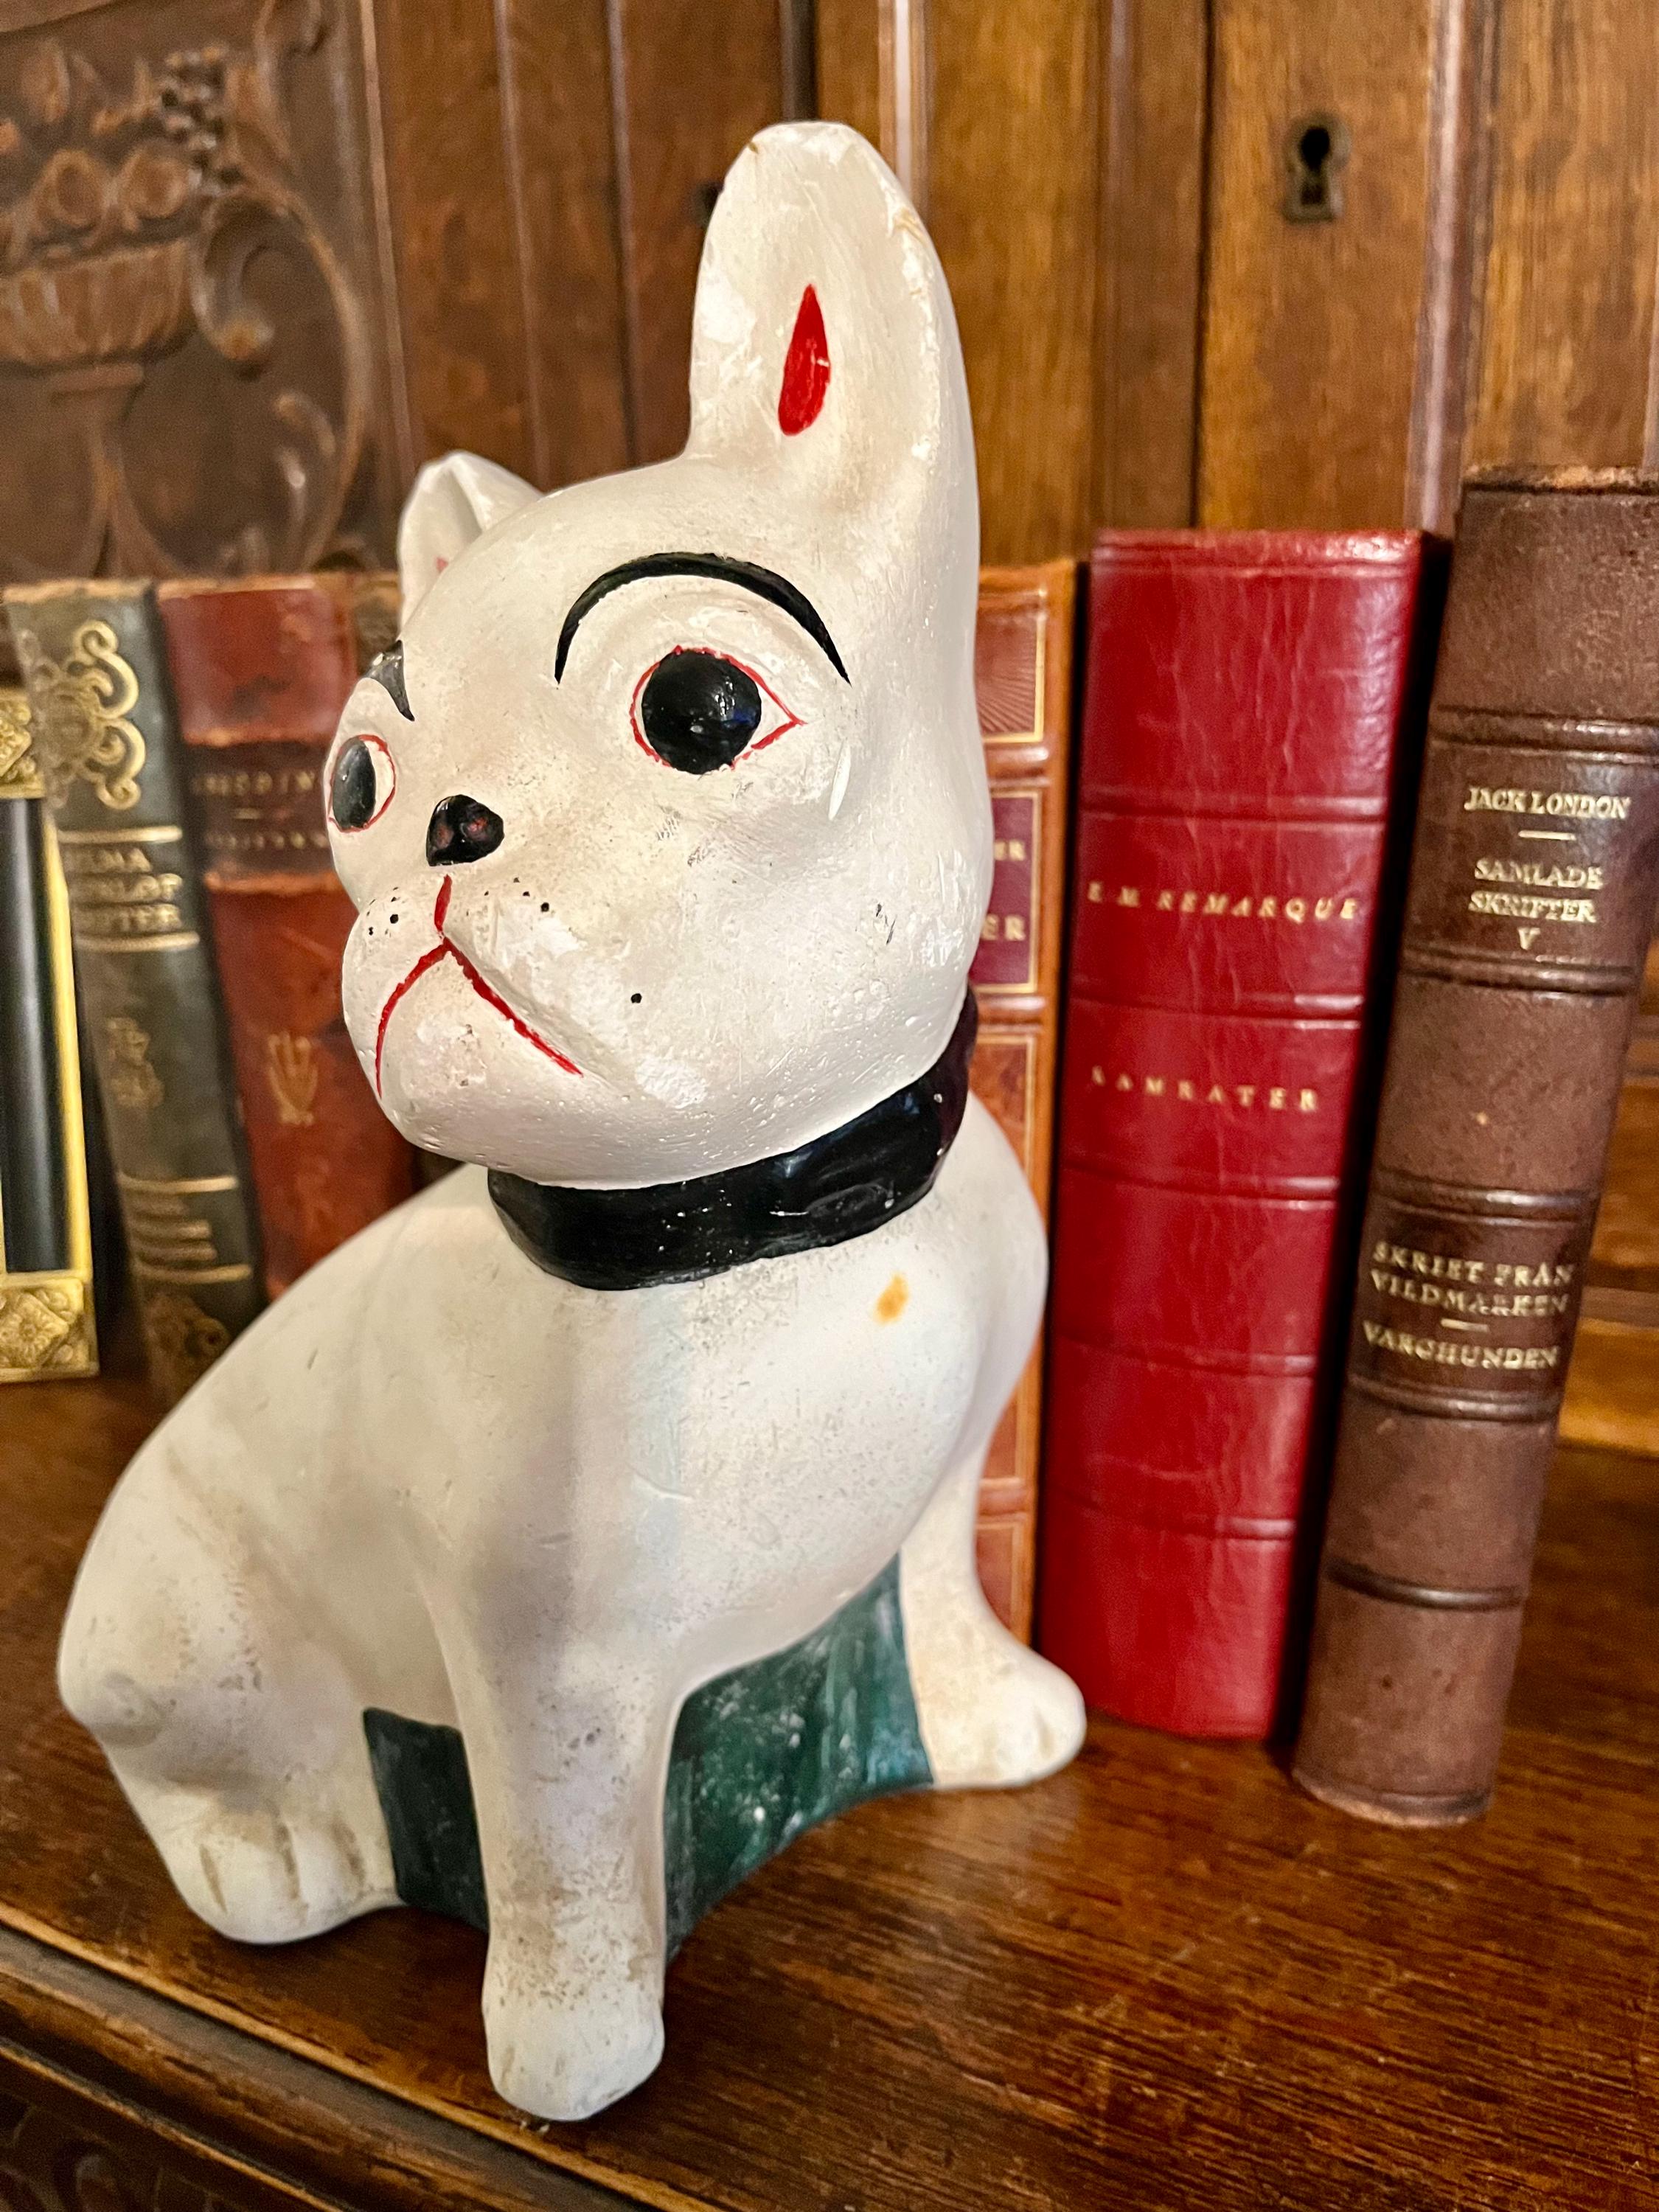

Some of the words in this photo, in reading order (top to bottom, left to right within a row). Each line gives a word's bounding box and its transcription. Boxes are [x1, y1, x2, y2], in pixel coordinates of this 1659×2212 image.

[1464, 785, 1526, 812] JACK
[1529, 790, 1632, 820] LONDON
[1475, 857, 1604, 890] SAMLADE
[1468, 890, 1597, 922] SKRIFTER
[1517, 926, 1541, 950] V
